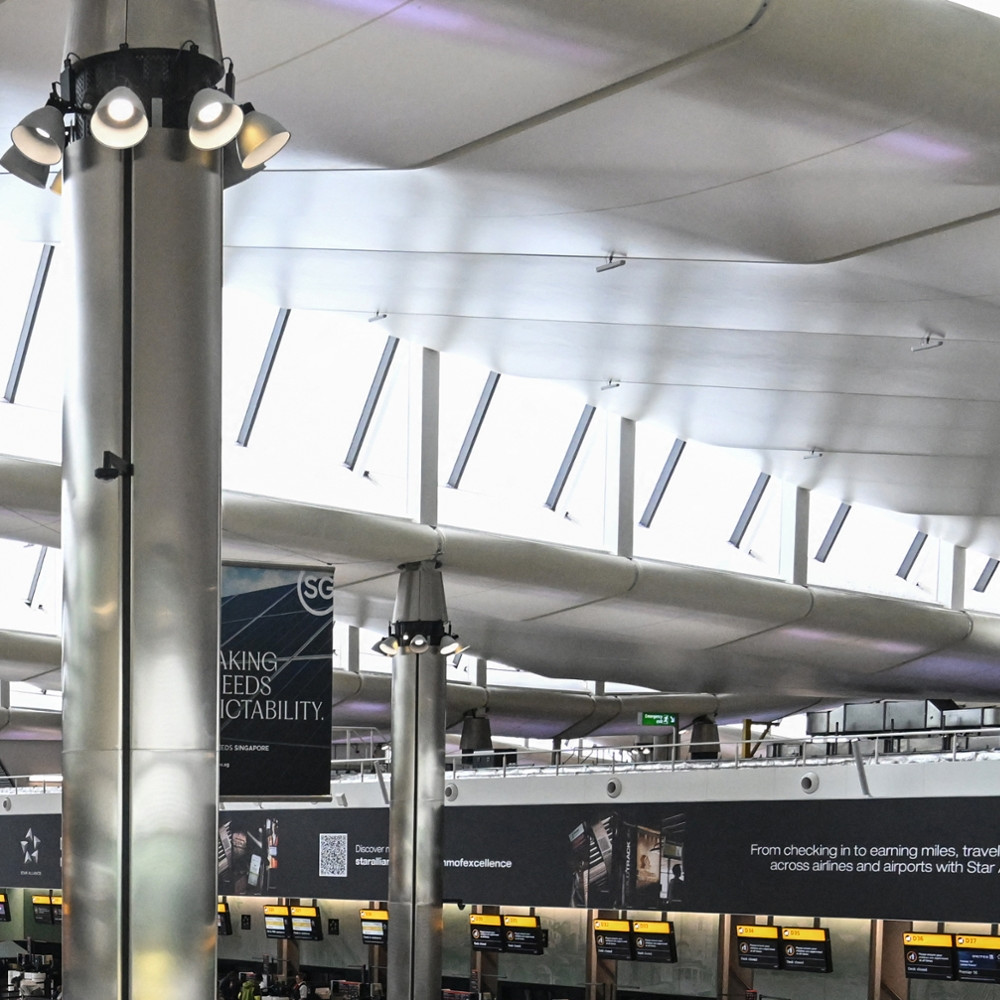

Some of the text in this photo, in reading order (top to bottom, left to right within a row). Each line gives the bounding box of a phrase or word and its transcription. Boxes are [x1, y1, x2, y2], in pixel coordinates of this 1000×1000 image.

[303, 576, 333, 600] SG
[220, 651, 278, 672] AKING
[222, 675, 272, 696] EEDS
[220, 699, 325, 721] ICTABILITY.
[355, 845, 385, 853] Discover
[750, 844, 781, 856] From
[783, 844, 838, 859] checking
[840, 844, 851, 856] in
[854, 845, 867, 857] to
[870, 845, 918, 859] earning
[921, 844, 959, 858] miles,
[770, 860, 995, 874] across airlines and airports with Star
